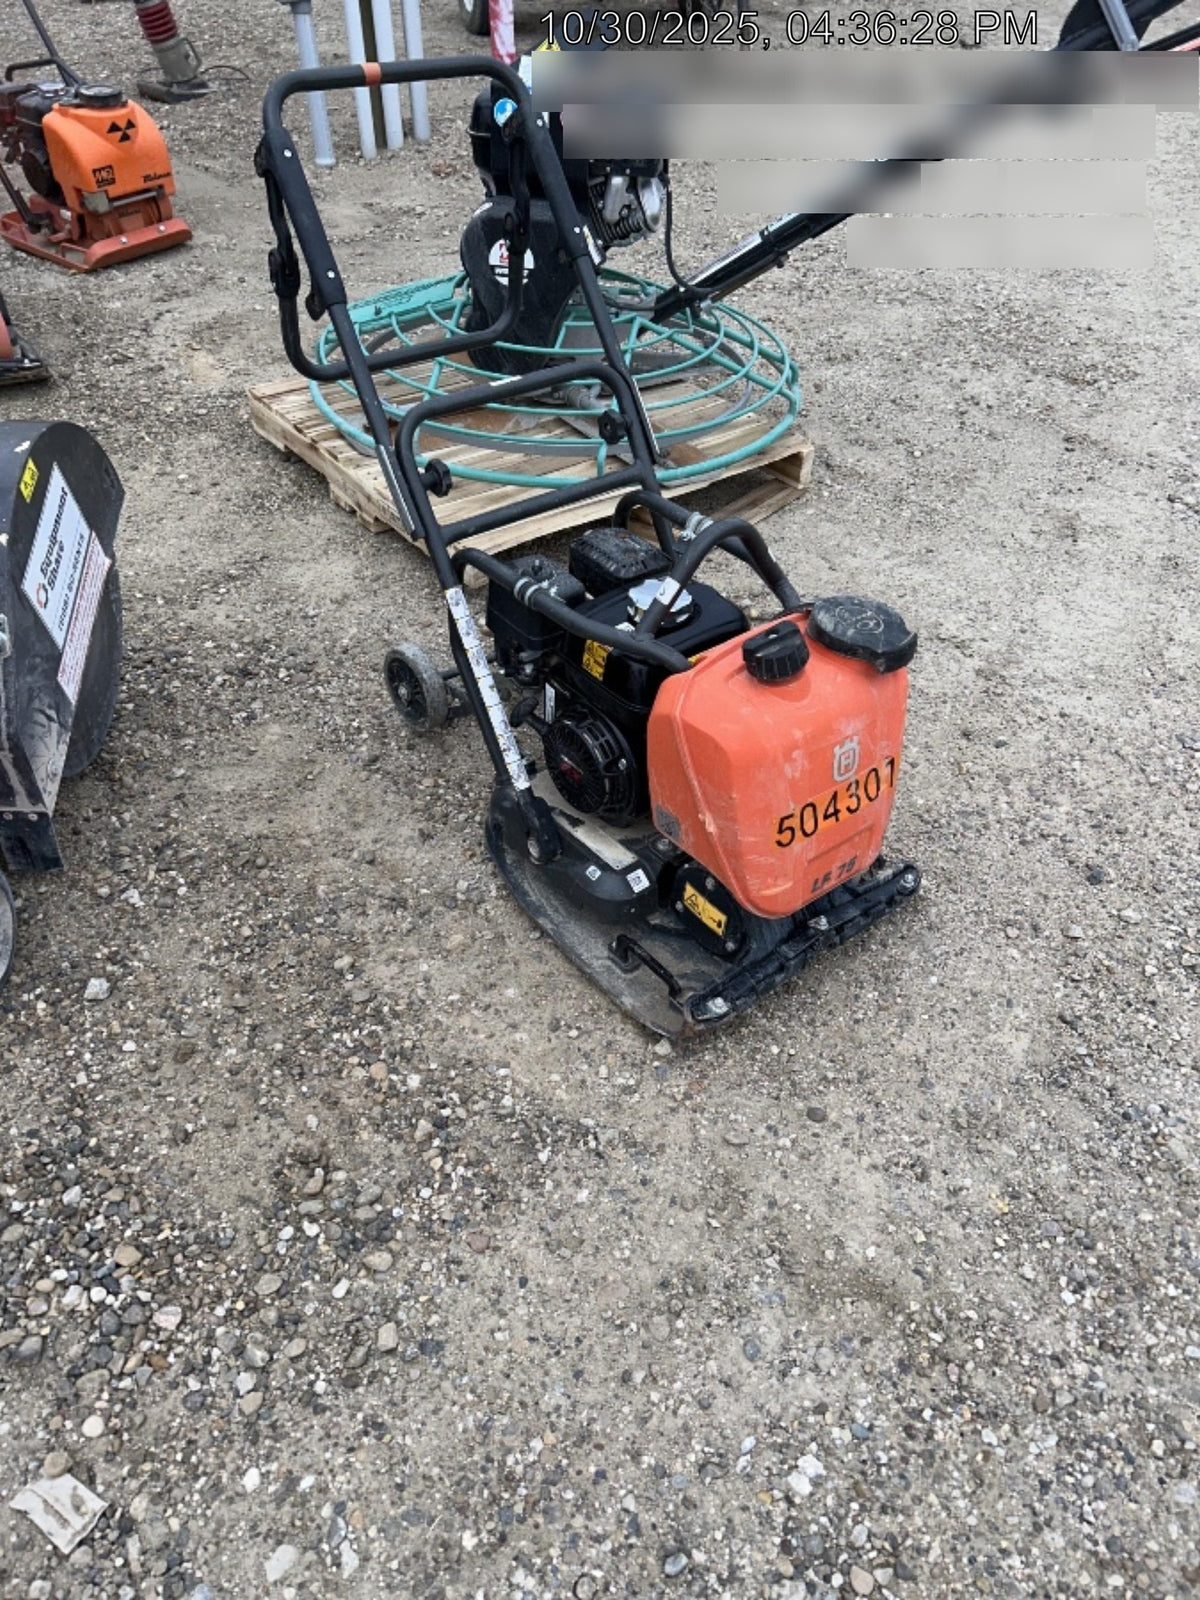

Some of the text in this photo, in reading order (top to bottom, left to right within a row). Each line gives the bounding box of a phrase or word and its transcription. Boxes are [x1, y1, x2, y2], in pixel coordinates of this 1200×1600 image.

[40, 486, 68, 581] Equipment
[48, 540, 65, 591] Share
[775, 756, 895, 848] 504301
